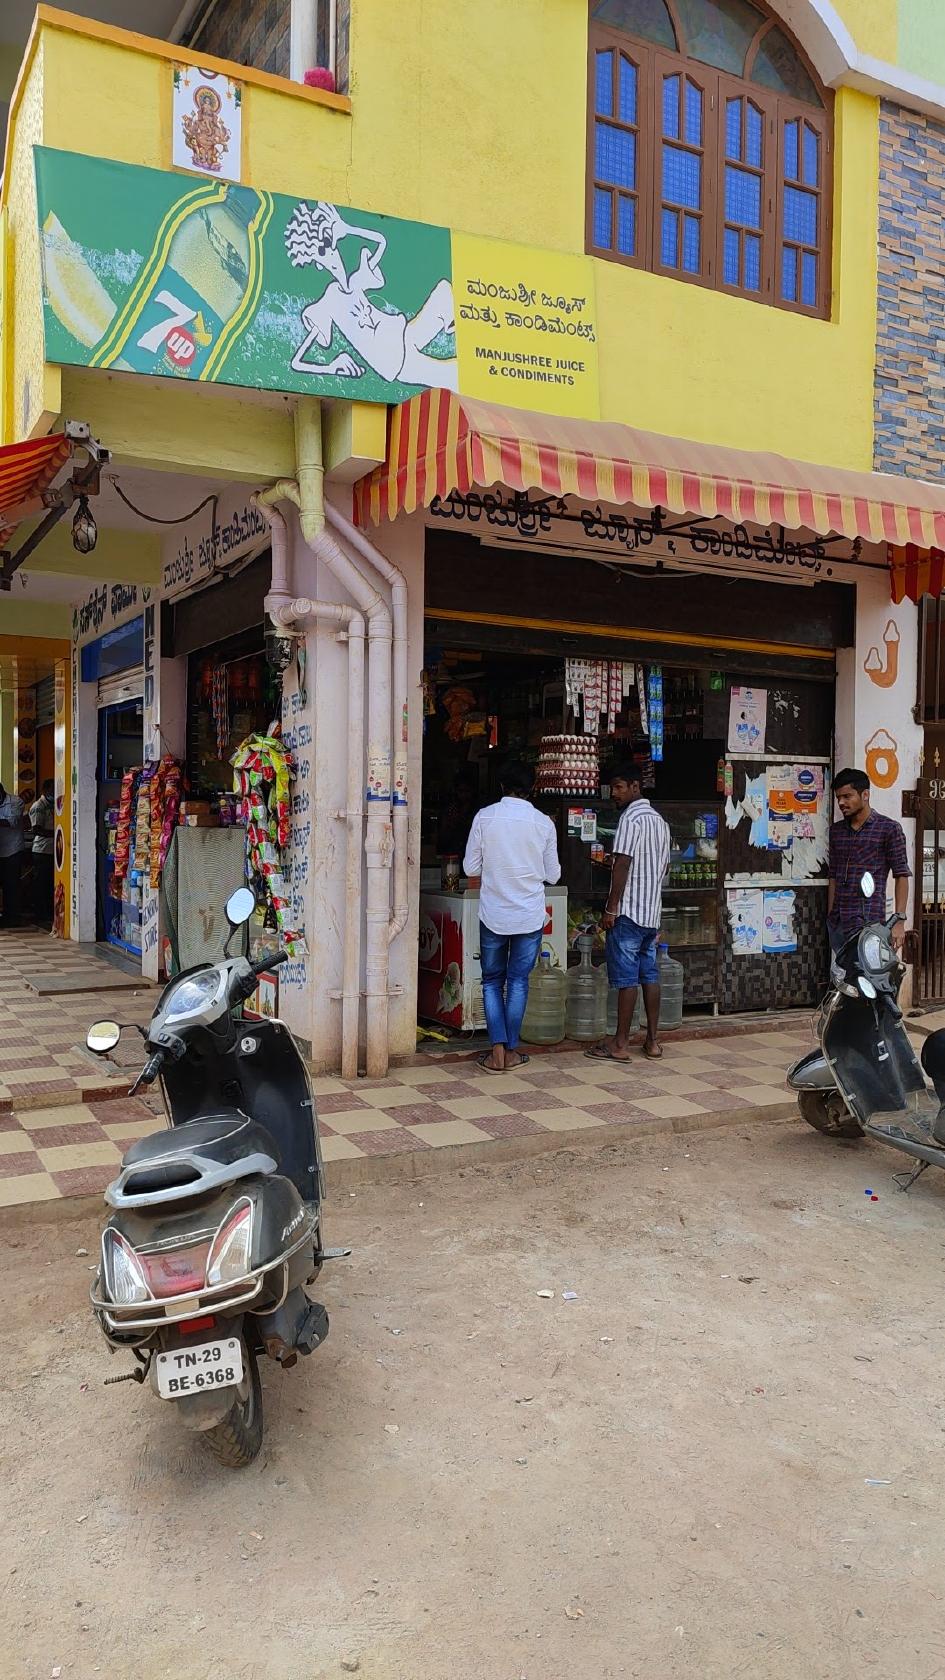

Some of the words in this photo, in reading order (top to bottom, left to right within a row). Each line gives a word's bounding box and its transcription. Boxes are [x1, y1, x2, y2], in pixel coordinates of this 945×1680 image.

[467, 278, 536, 307] ಮಂಜುಶ್ರೀ
[541, 292, 586, 315] ಜ್ಯೂಸ್
[460, 304, 500, 328] ಮತ್ತು
[505, 312, 595, 342] ಕಾಂಡಿಮೆಂಟ್ಸ್
[475, 347, 552, 368] MANJUSHREE
[556, 360, 585, 372] JUICE
[489, 365, 498, 375] &
[501, 367, 574, 385] CONDIMENTS
[173, 1347, 221, 1368] TN-29
[168, 1367, 235, 1392] BE-6368
